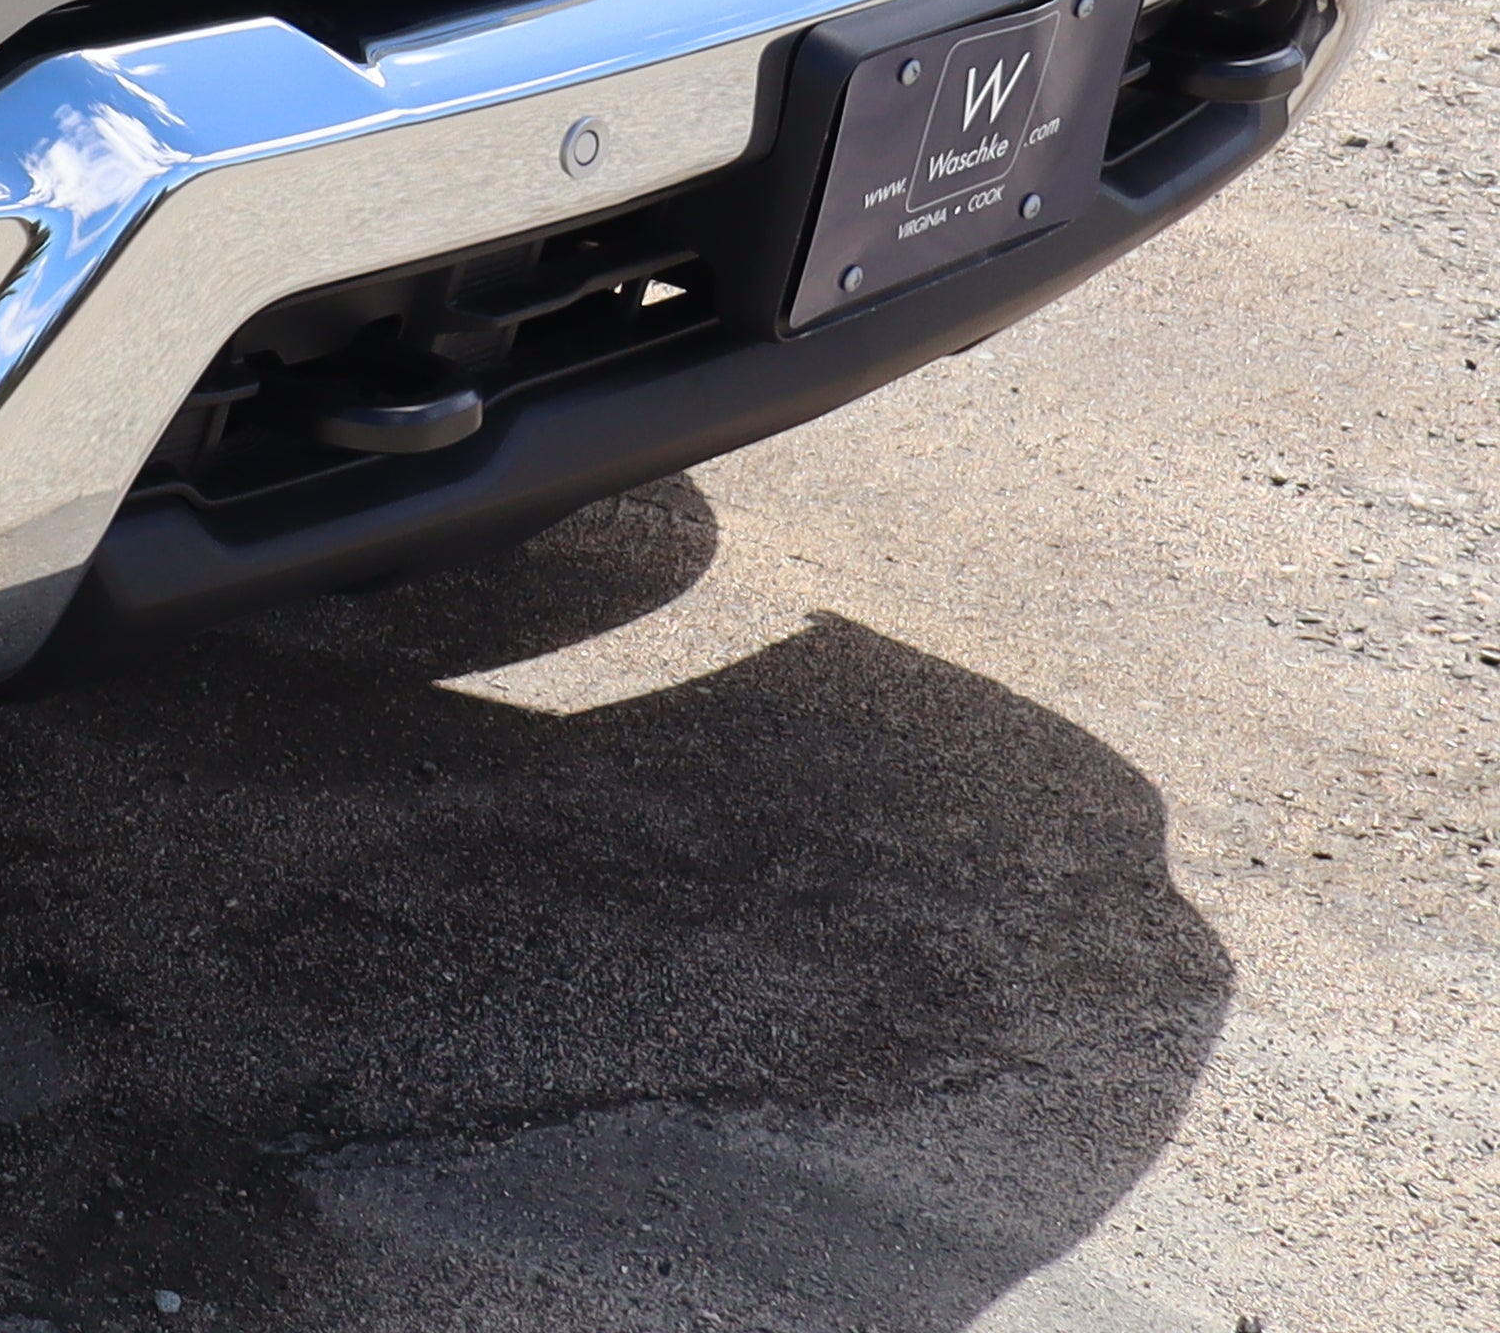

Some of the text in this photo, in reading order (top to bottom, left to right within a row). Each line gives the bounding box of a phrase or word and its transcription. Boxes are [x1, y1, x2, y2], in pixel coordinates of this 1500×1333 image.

[962, 51, 1031, 132] W
[927, 132, 1010, 183] Waschke
[897, 184, 1006, 240] VIRGINIA COOK
